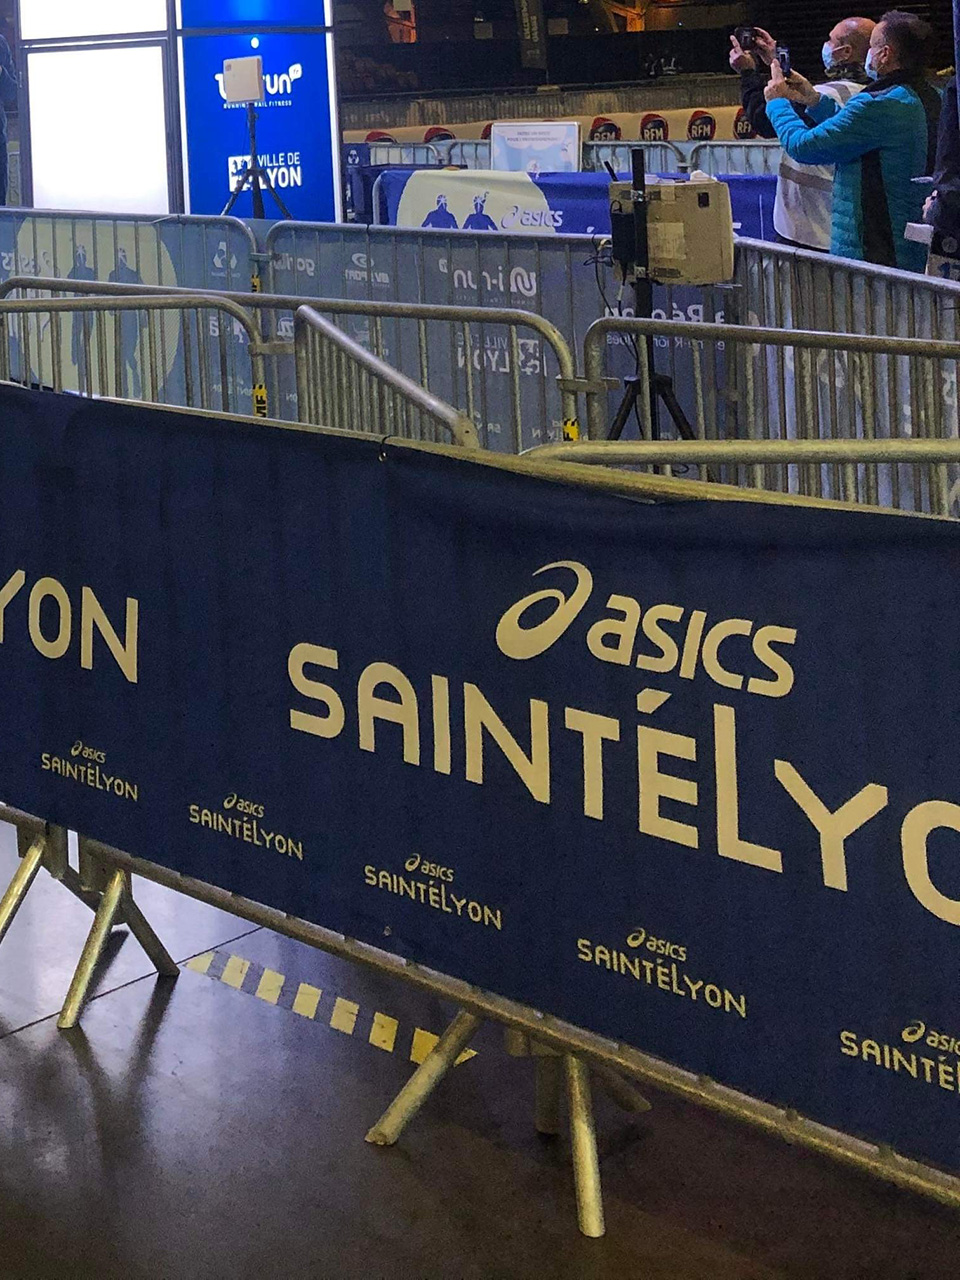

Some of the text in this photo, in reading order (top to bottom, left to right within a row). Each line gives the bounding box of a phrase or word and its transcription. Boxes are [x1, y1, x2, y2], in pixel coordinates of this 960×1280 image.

[643, 127, 664, 141] RFM
[691, 124, 711, 138] RFM
[287, 152, 301, 165] DE
[586, 593, 798, 698] asics
[82, 747, 105, 763] asics
[41, 752, 139, 803] SAINTÉLYON
[286, 641, 960, 927] SAINTÉLYO
[237, 799, 264, 817] asics
[189, 803, 305, 863] SAINTÉLYON
[421, 861, 453, 885] asics
[363, 863, 504, 932] SAINTÉLYON
[646, 937, 686, 963] asics
[576, 937, 748, 1019] SAINTÉLYON
[840, 1029, 960, 1092] SAINTÉ
